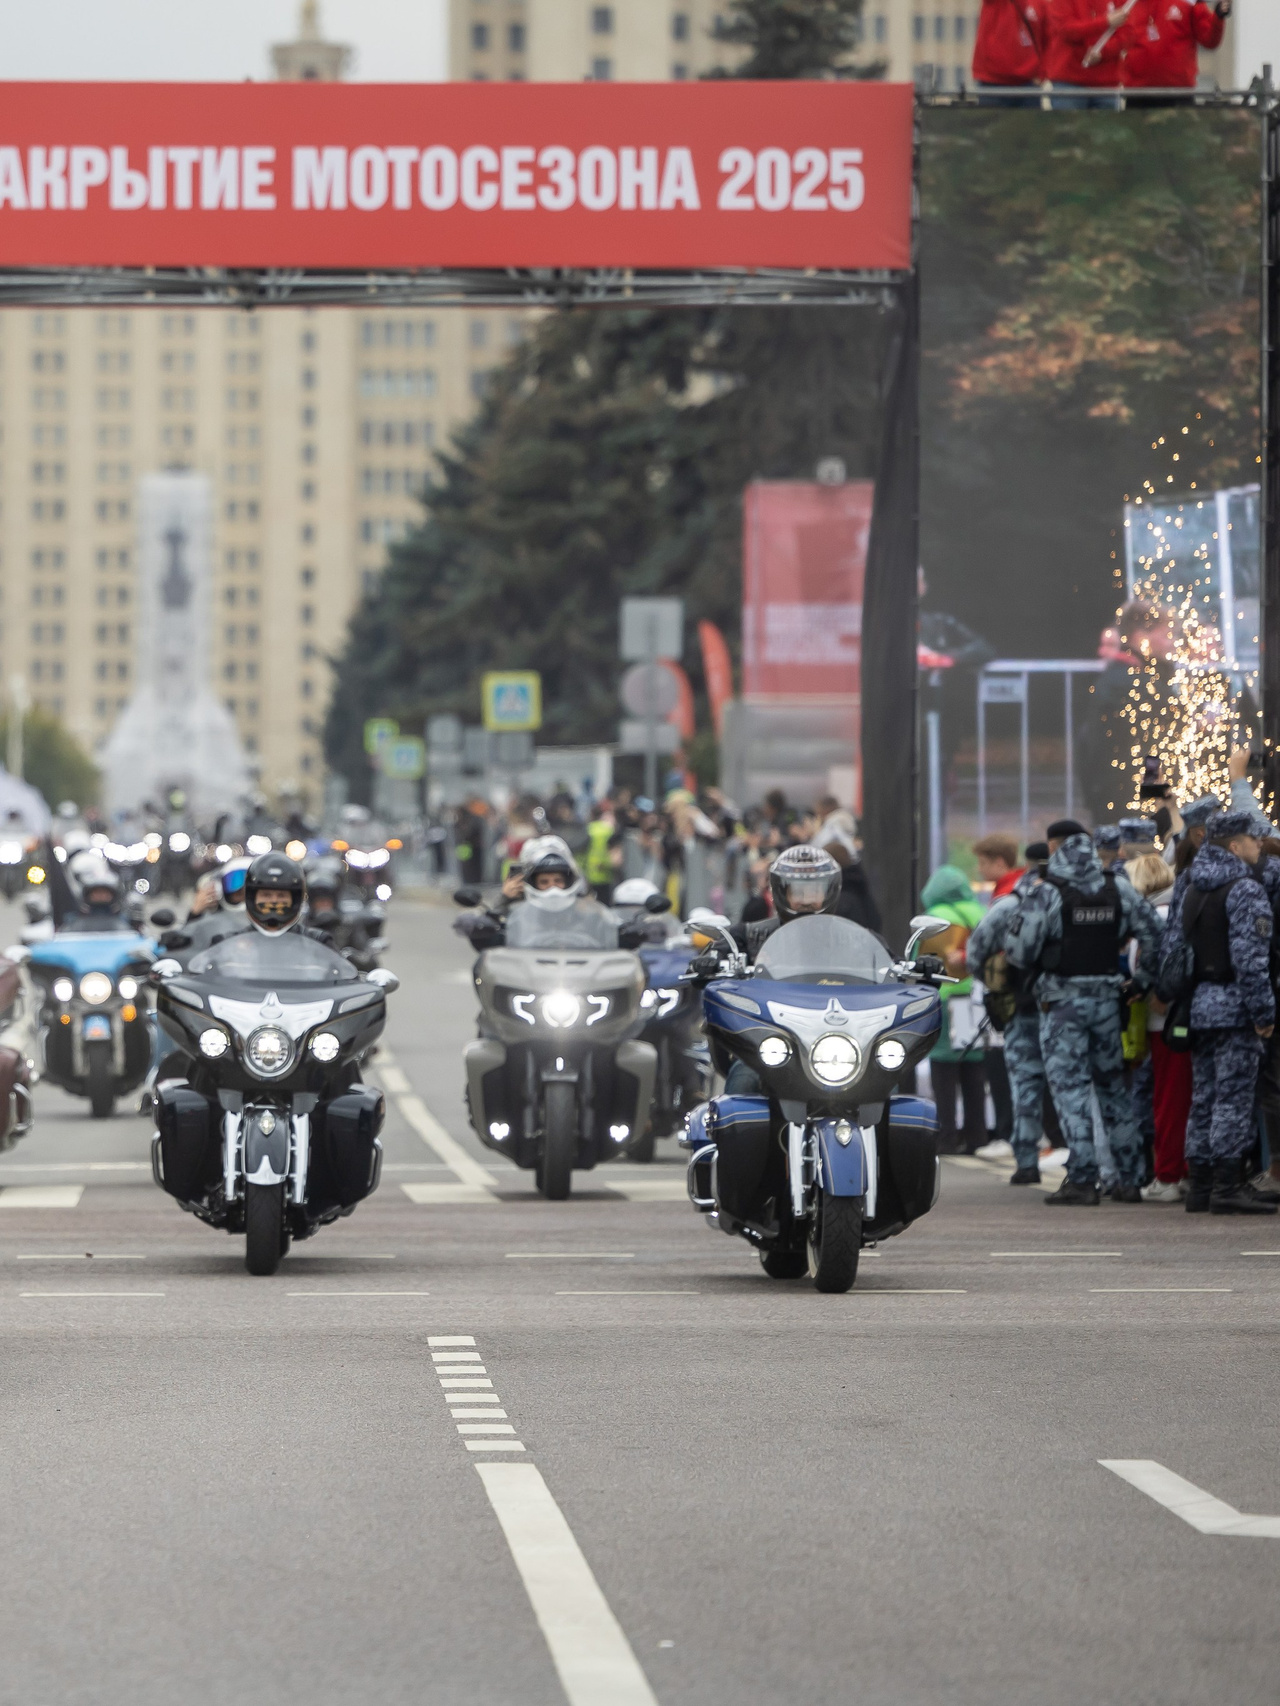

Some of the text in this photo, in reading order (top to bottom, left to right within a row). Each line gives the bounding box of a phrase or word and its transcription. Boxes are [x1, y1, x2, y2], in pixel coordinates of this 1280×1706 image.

[292, 145, 700, 211] МОТОСЕЗОНА
[717, 147, 865, 212] 2025
[1075, 910, 1114, 922] ОМОН
